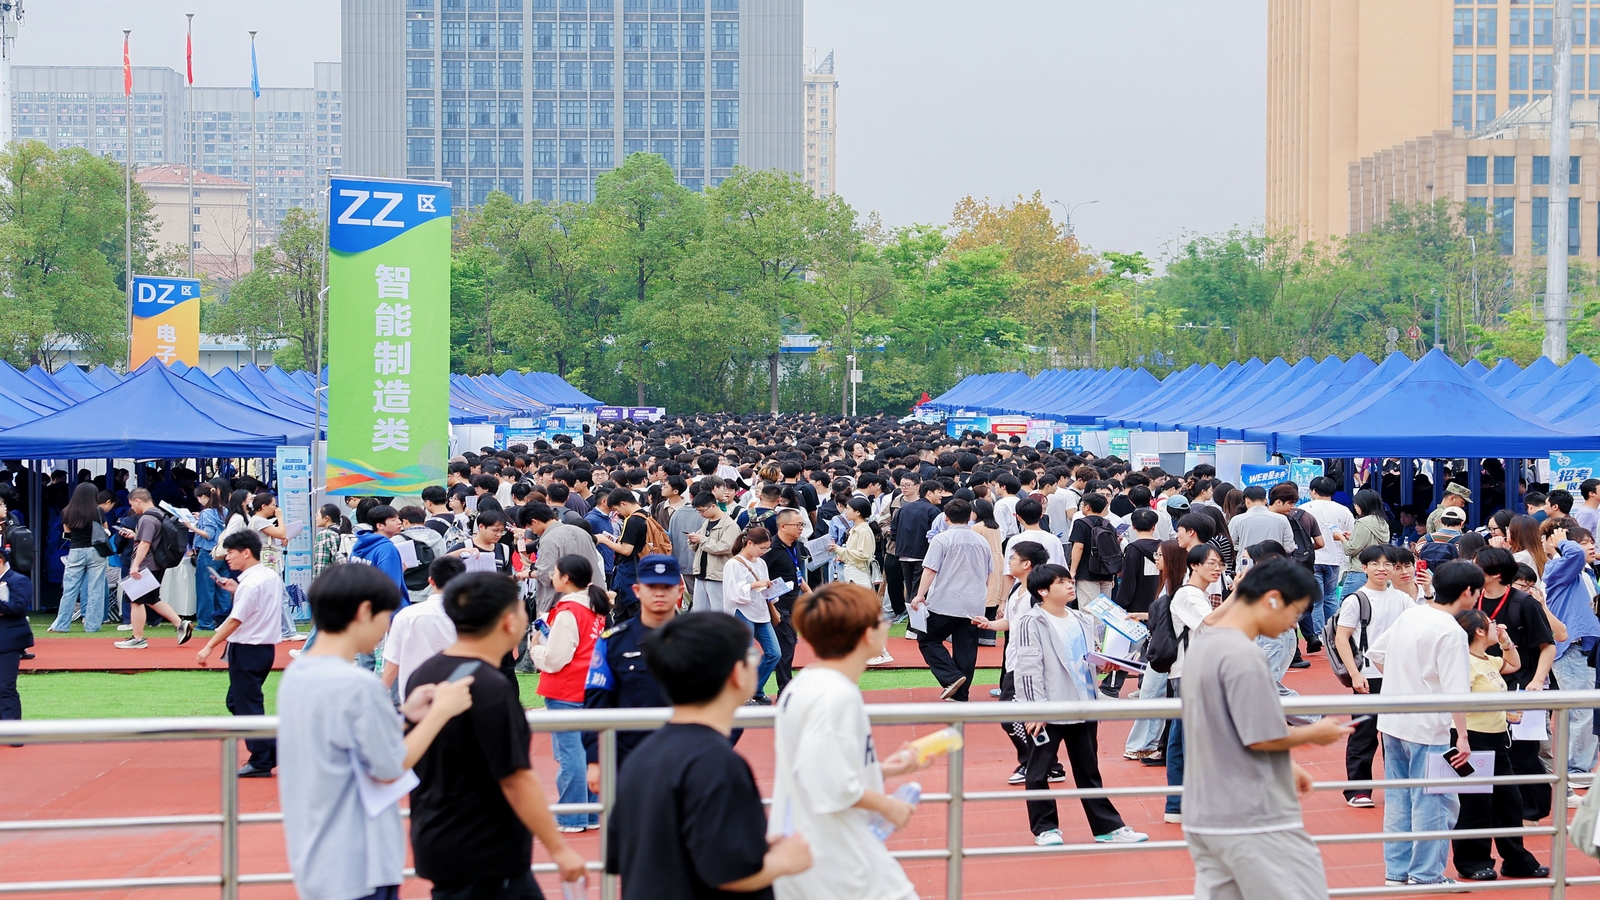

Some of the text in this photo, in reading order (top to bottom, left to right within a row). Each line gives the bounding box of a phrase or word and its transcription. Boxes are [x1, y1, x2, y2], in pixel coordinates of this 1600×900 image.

[338, 189, 436, 228] ZZ 区
[138, 283, 192, 304] DZ 区
[372, 264, 412, 452] 智能制造类
[1558, 469, 1590, 482] 招考
